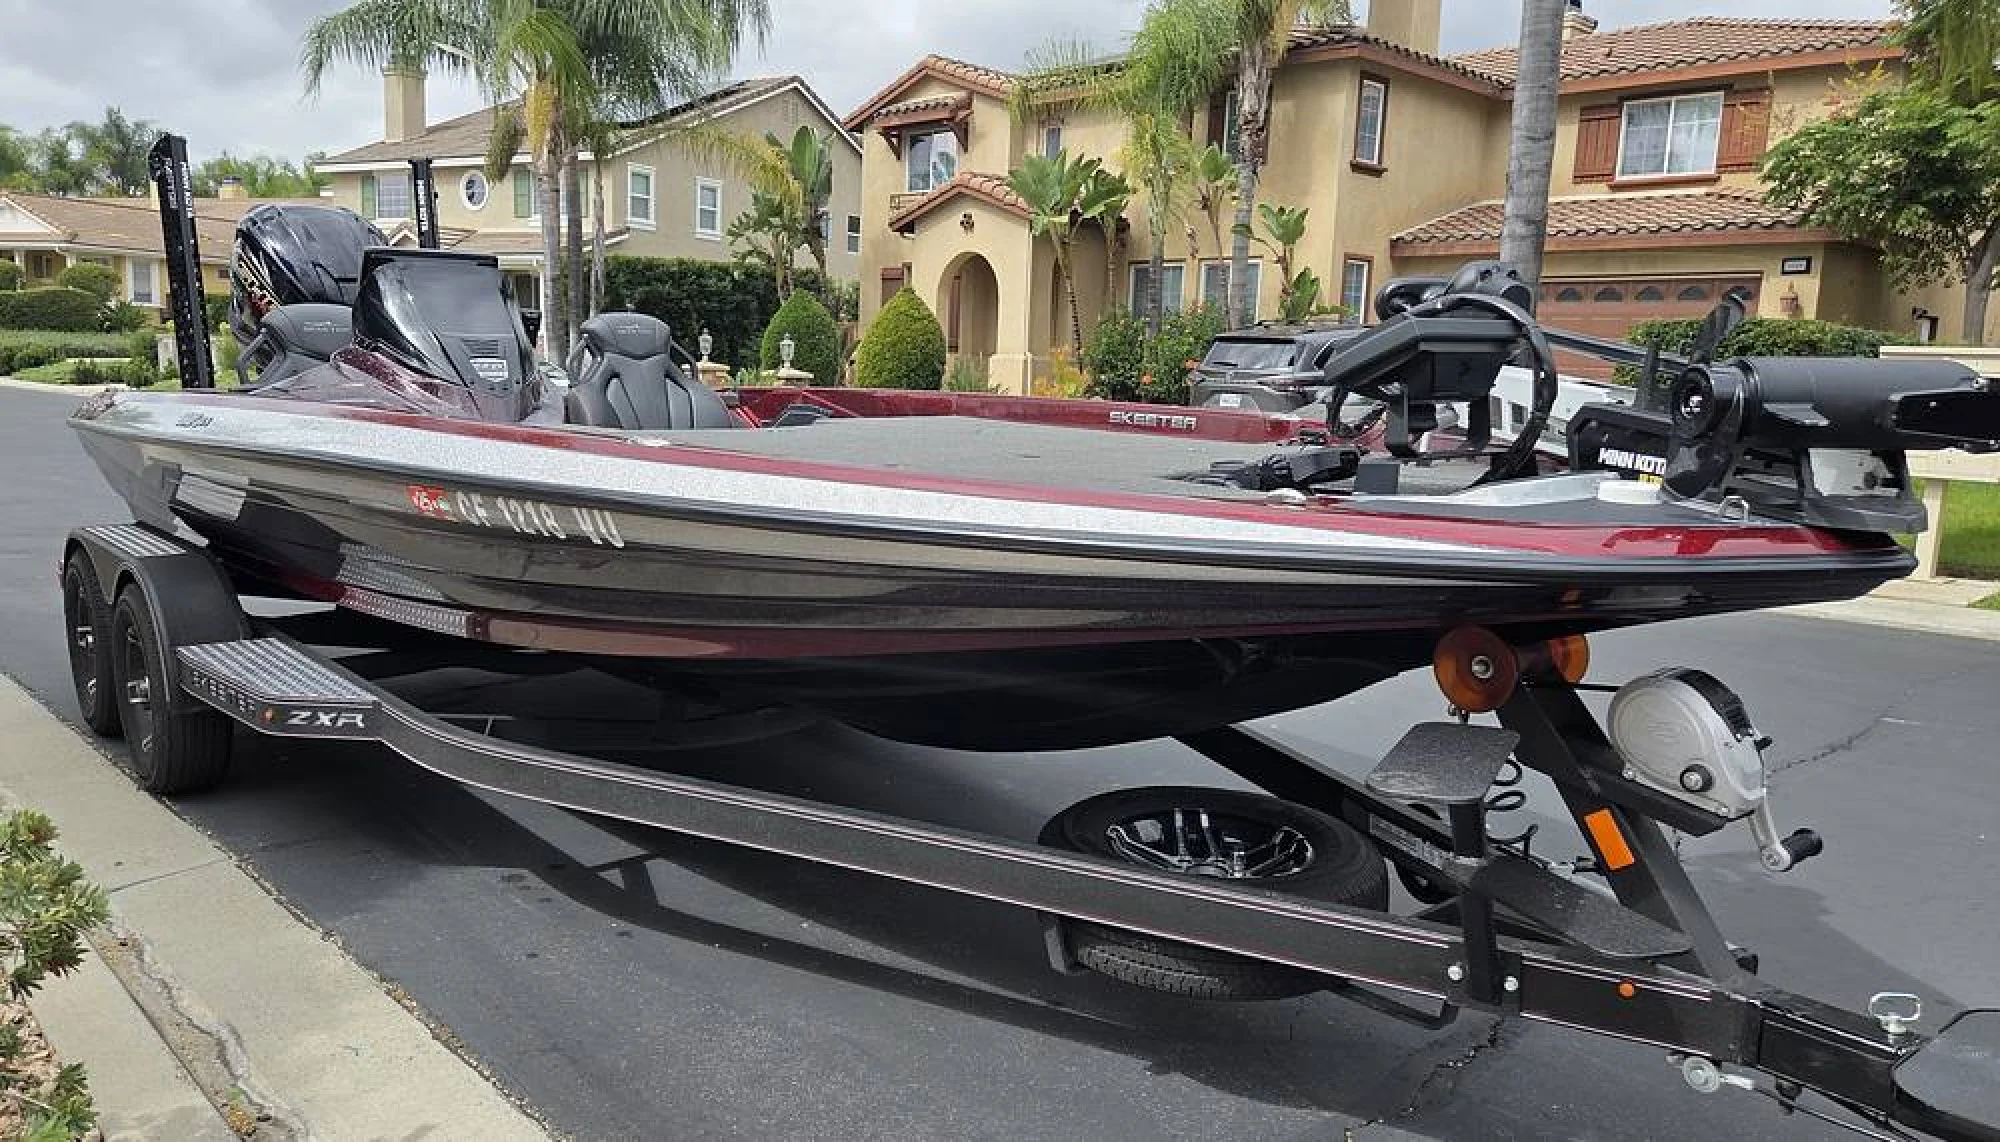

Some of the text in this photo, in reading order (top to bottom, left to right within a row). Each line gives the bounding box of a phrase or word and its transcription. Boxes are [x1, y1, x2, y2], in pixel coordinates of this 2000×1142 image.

[1109, 411, 1197, 431] SKEETER
[1597, 447, 1634, 469] MINN
[456, 491, 491, 527] CF
[286, 711, 364, 728] ZXR
